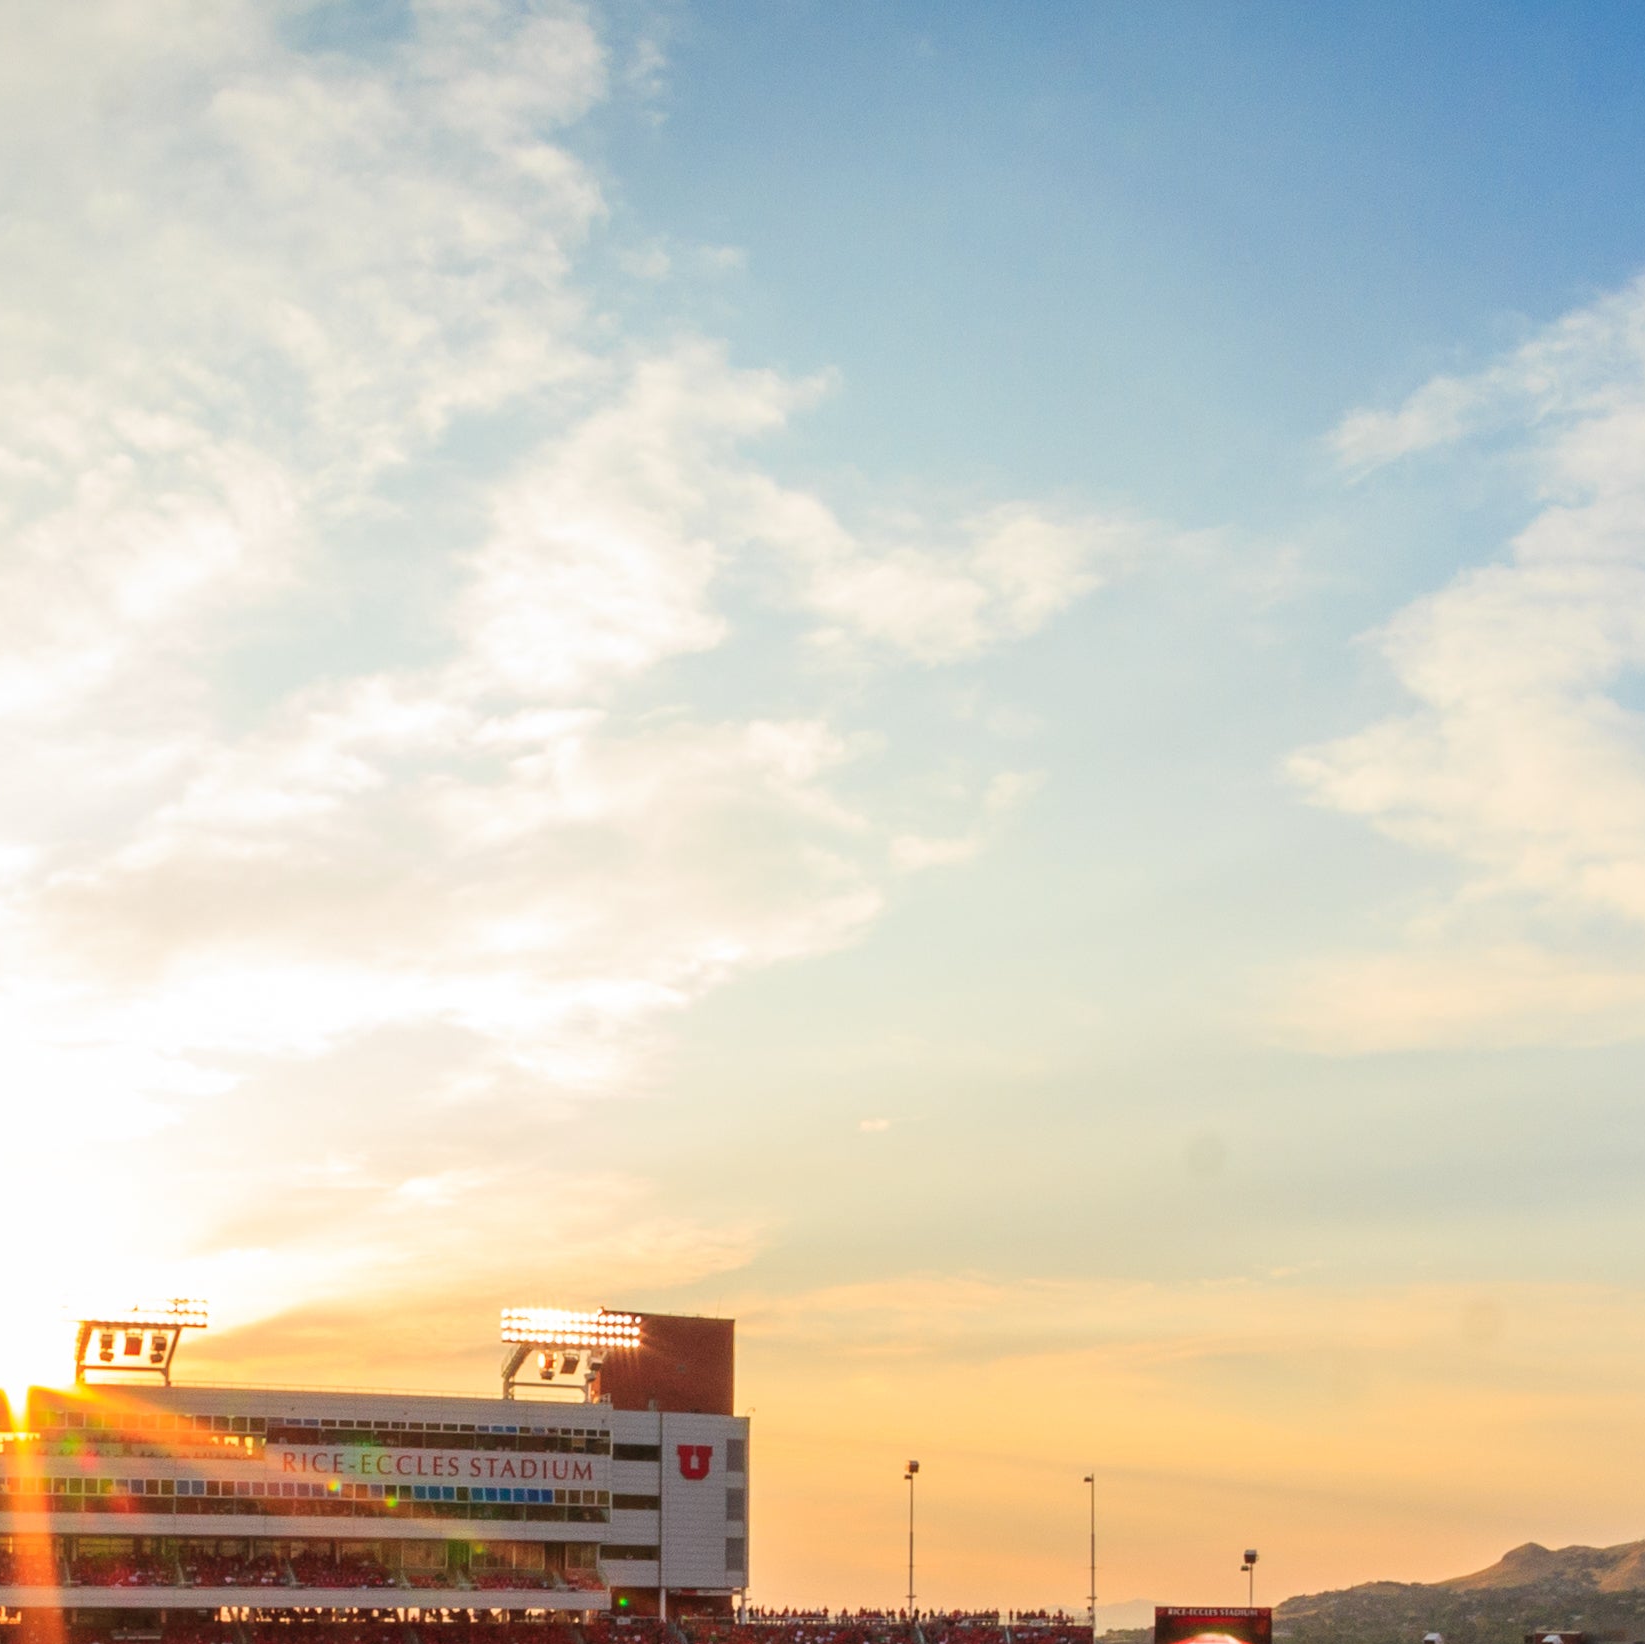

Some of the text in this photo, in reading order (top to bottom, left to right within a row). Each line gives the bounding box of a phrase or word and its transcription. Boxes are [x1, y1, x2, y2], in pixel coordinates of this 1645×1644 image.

[282, 1451, 594, 1482] RICE-ECCLES STADIUM
[677, 1445, 714, 1480] U
[1167, 1608, 1258, 1618] RICE-ECCLES STADIUM
